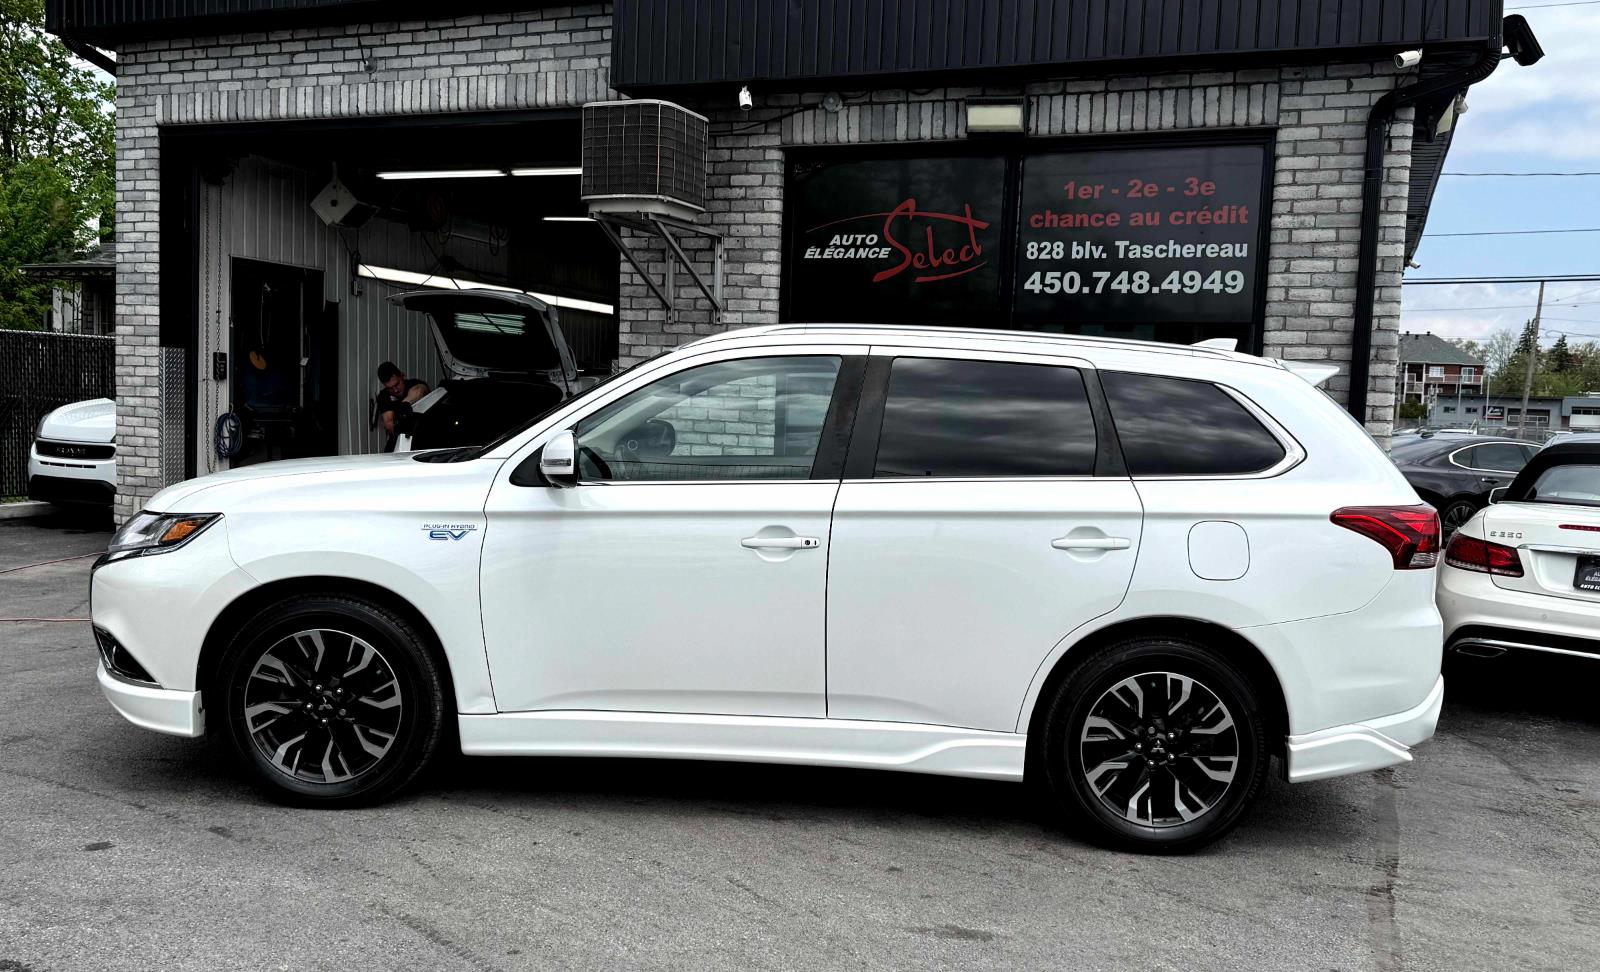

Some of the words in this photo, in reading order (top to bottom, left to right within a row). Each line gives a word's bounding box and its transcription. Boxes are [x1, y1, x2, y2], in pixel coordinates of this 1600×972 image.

[1063, 181, 1104, 200] 1er
[1126, 179, 1159, 198] 2e
[1183, 176, 1216, 196] 3e
[1029, 210, 1121, 228] chance
[1129, 211, 1160, 226] au
[1169, 204, 1249, 225] crédit
[829, 234, 878, 246] AUTO
[873, 198, 990, 282] Select
[1026, 241, 1065, 260] 828
[1071, 240, 1108, 260] blv.
[1115, 239, 1249, 259] Taschereau
[804, 246, 891, 259] ÉLÉGANCE
[1023, 270, 1245, 294] 450.748.4949
[429, 530, 470, 541] EV
